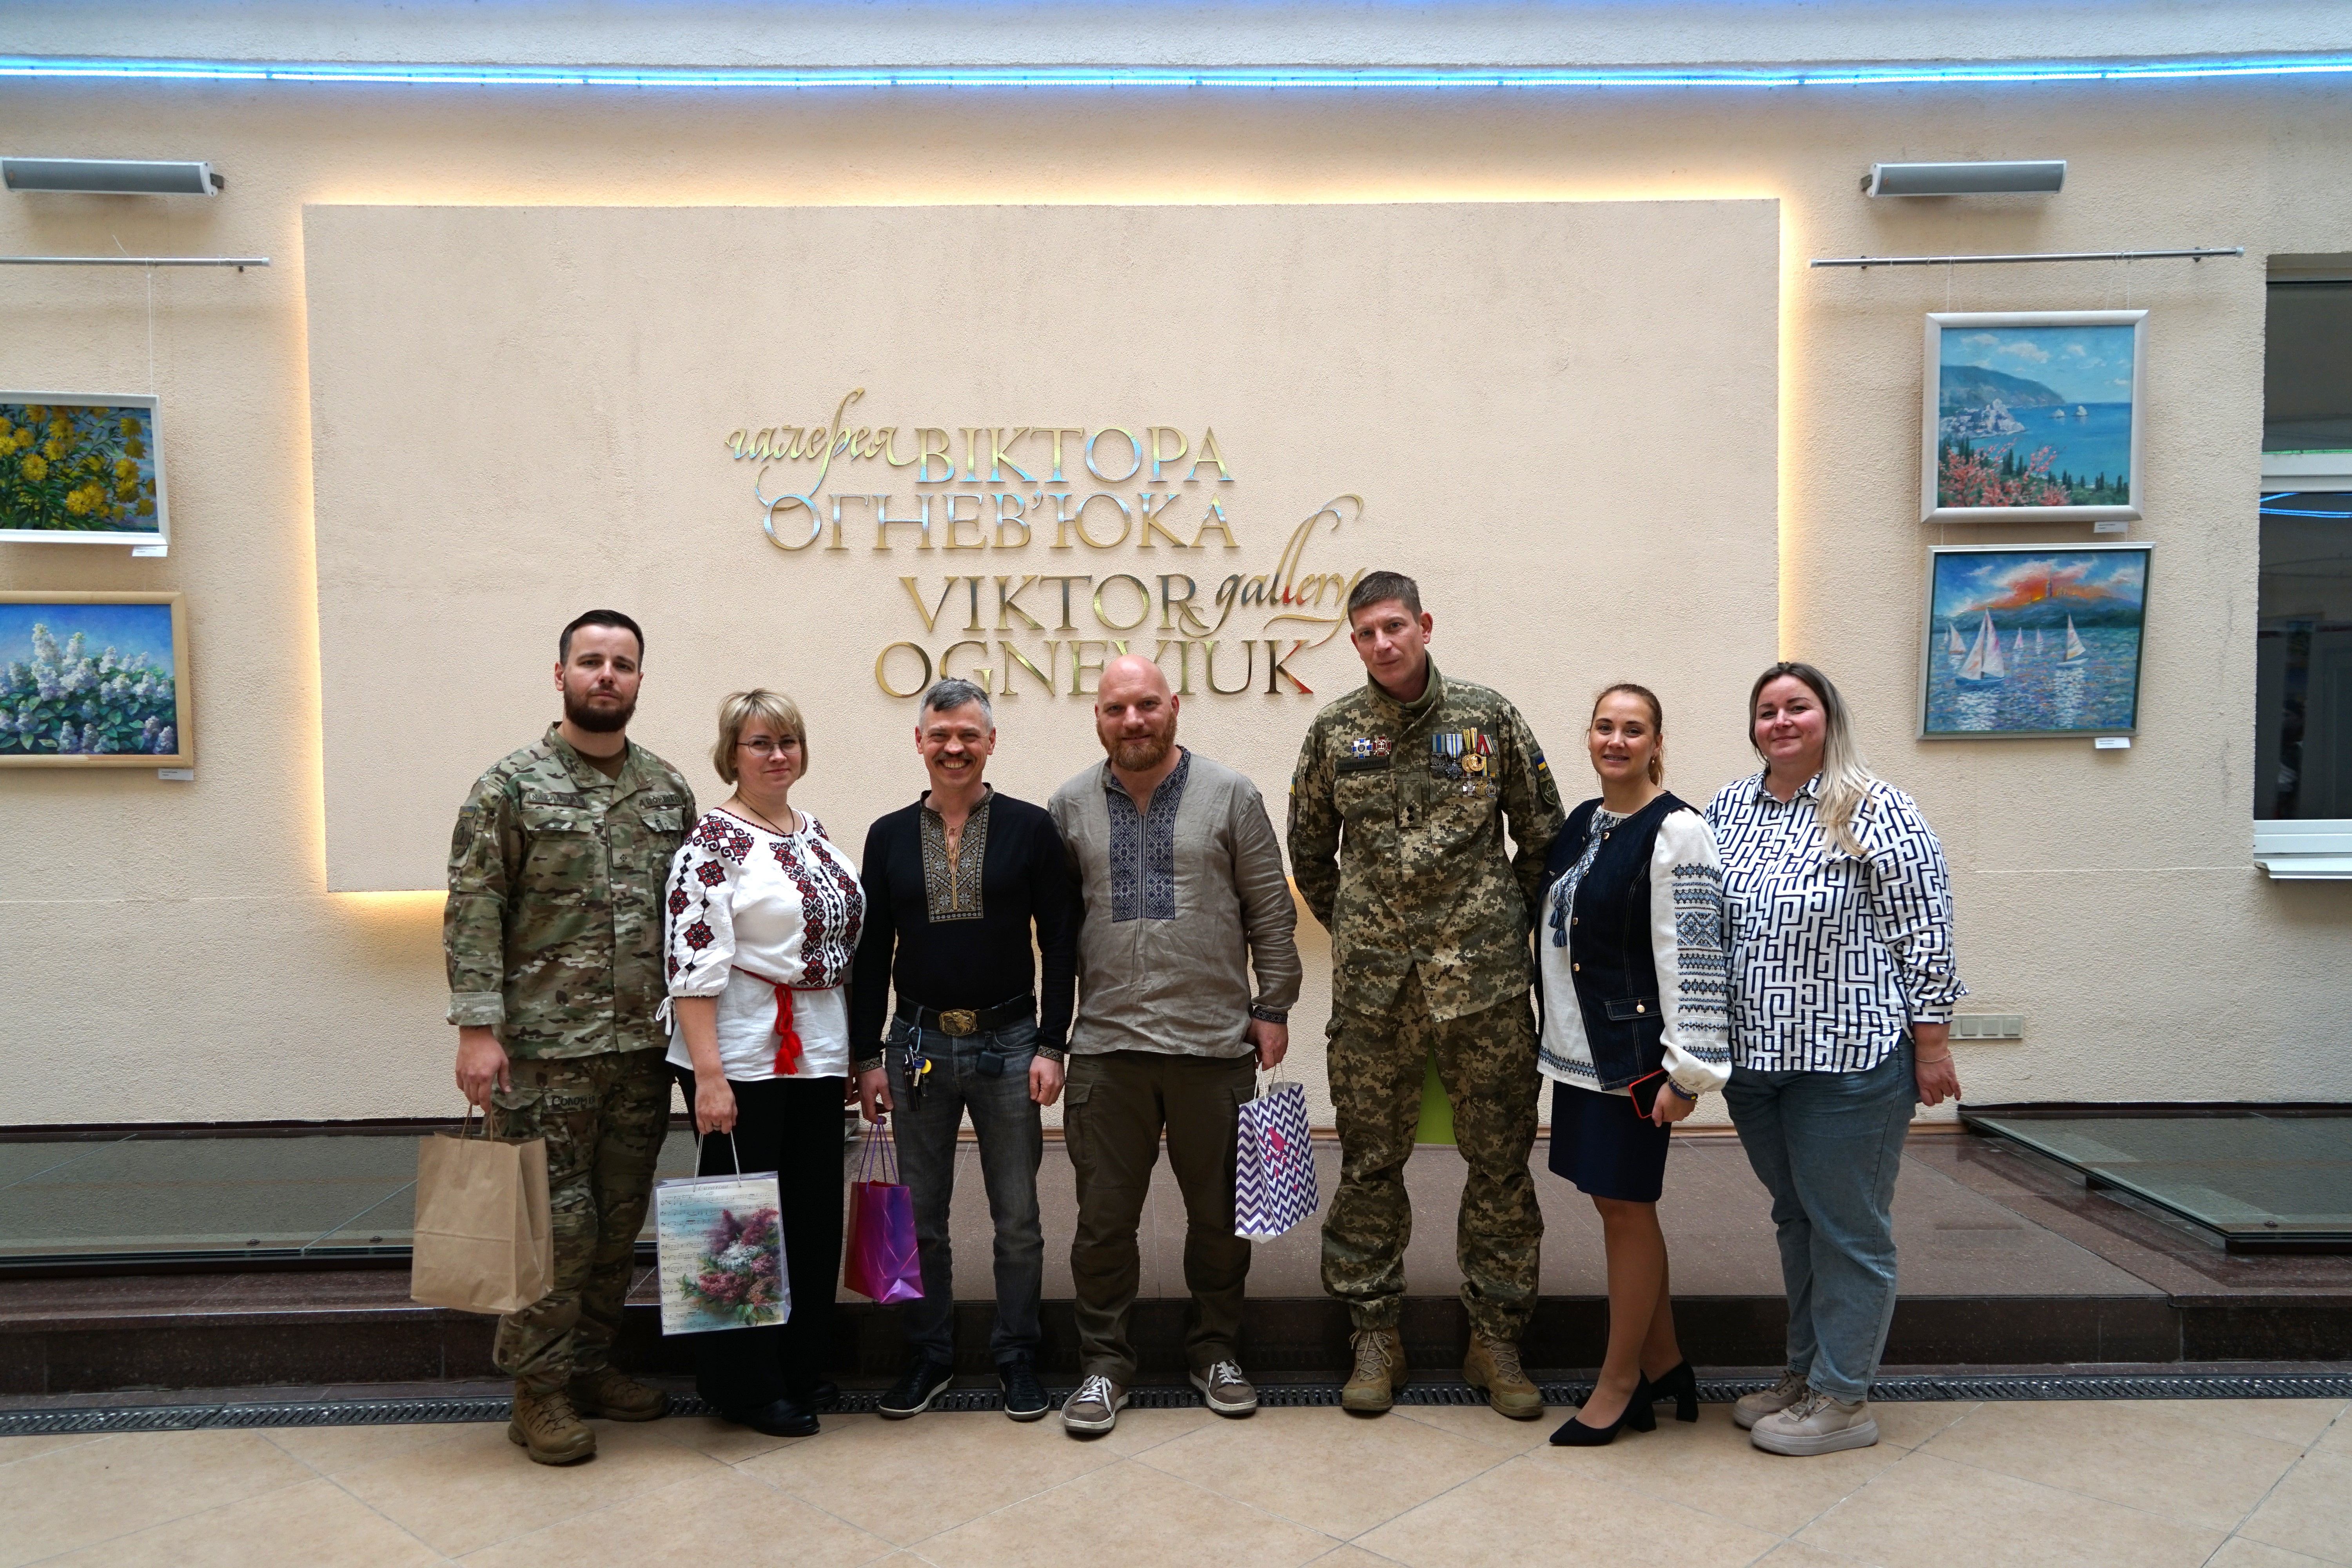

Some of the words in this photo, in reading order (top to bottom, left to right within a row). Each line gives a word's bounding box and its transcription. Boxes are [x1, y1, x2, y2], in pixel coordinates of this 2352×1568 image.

[915, 425, 1235, 483] ВІКТОРА
[898, 573, 1210, 632] VIKTOR
[1178, 493, 1367, 649] gallery
